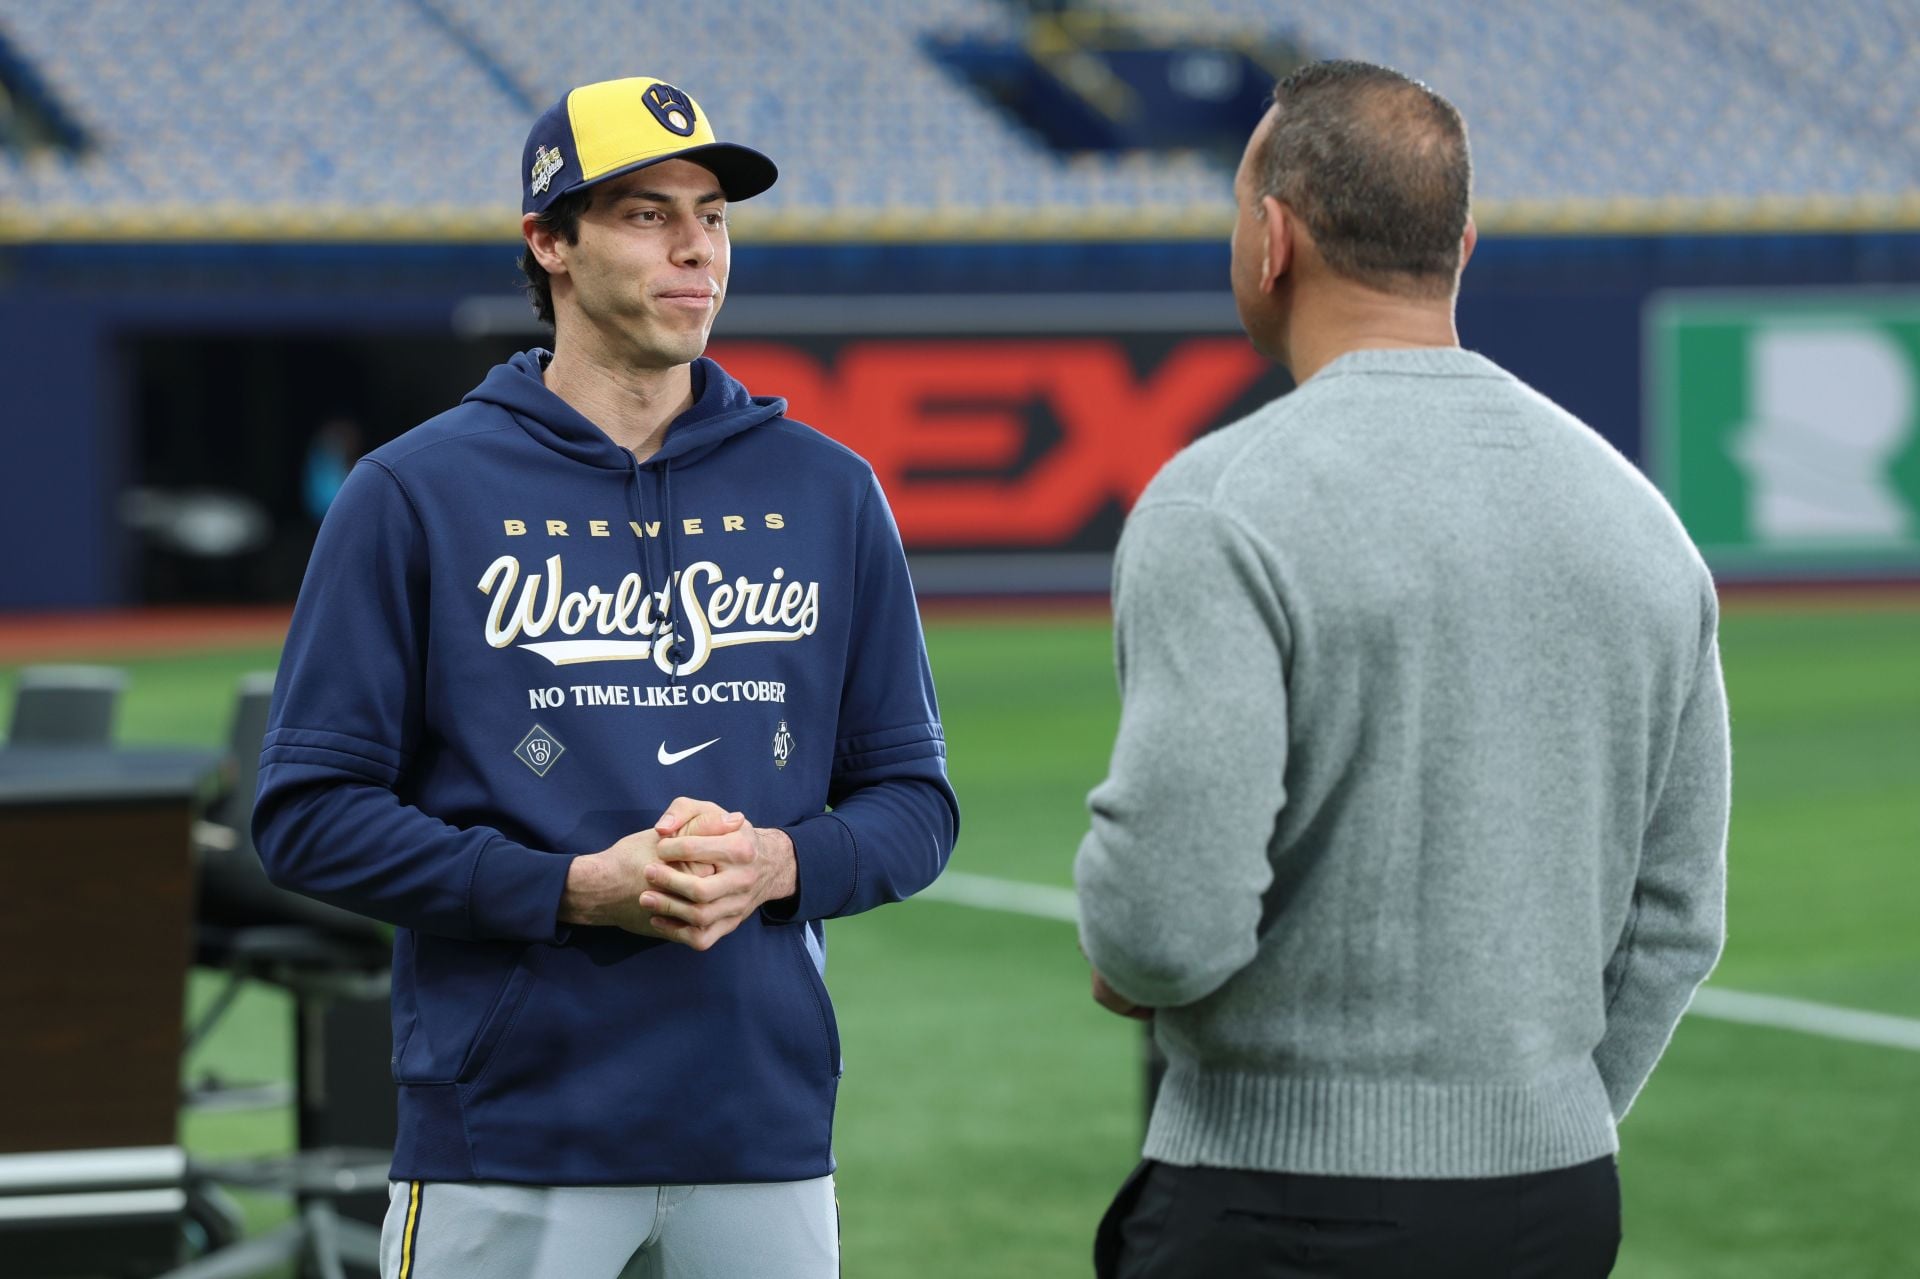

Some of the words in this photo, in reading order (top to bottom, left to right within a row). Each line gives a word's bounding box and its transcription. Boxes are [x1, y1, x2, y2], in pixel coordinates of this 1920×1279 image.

[703, 338, 1266, 542] EX
[503, 513, 786, 538] BREWERS
[477, 554, 681, 648] World
[652, 561, 820, 677] Series
[528, 687, 565, 710] NO
[570, 685, 630, 706] TIME
[634, 685, 688, 707] LIKE
[692, 680, 786, 703] OCTOBER
